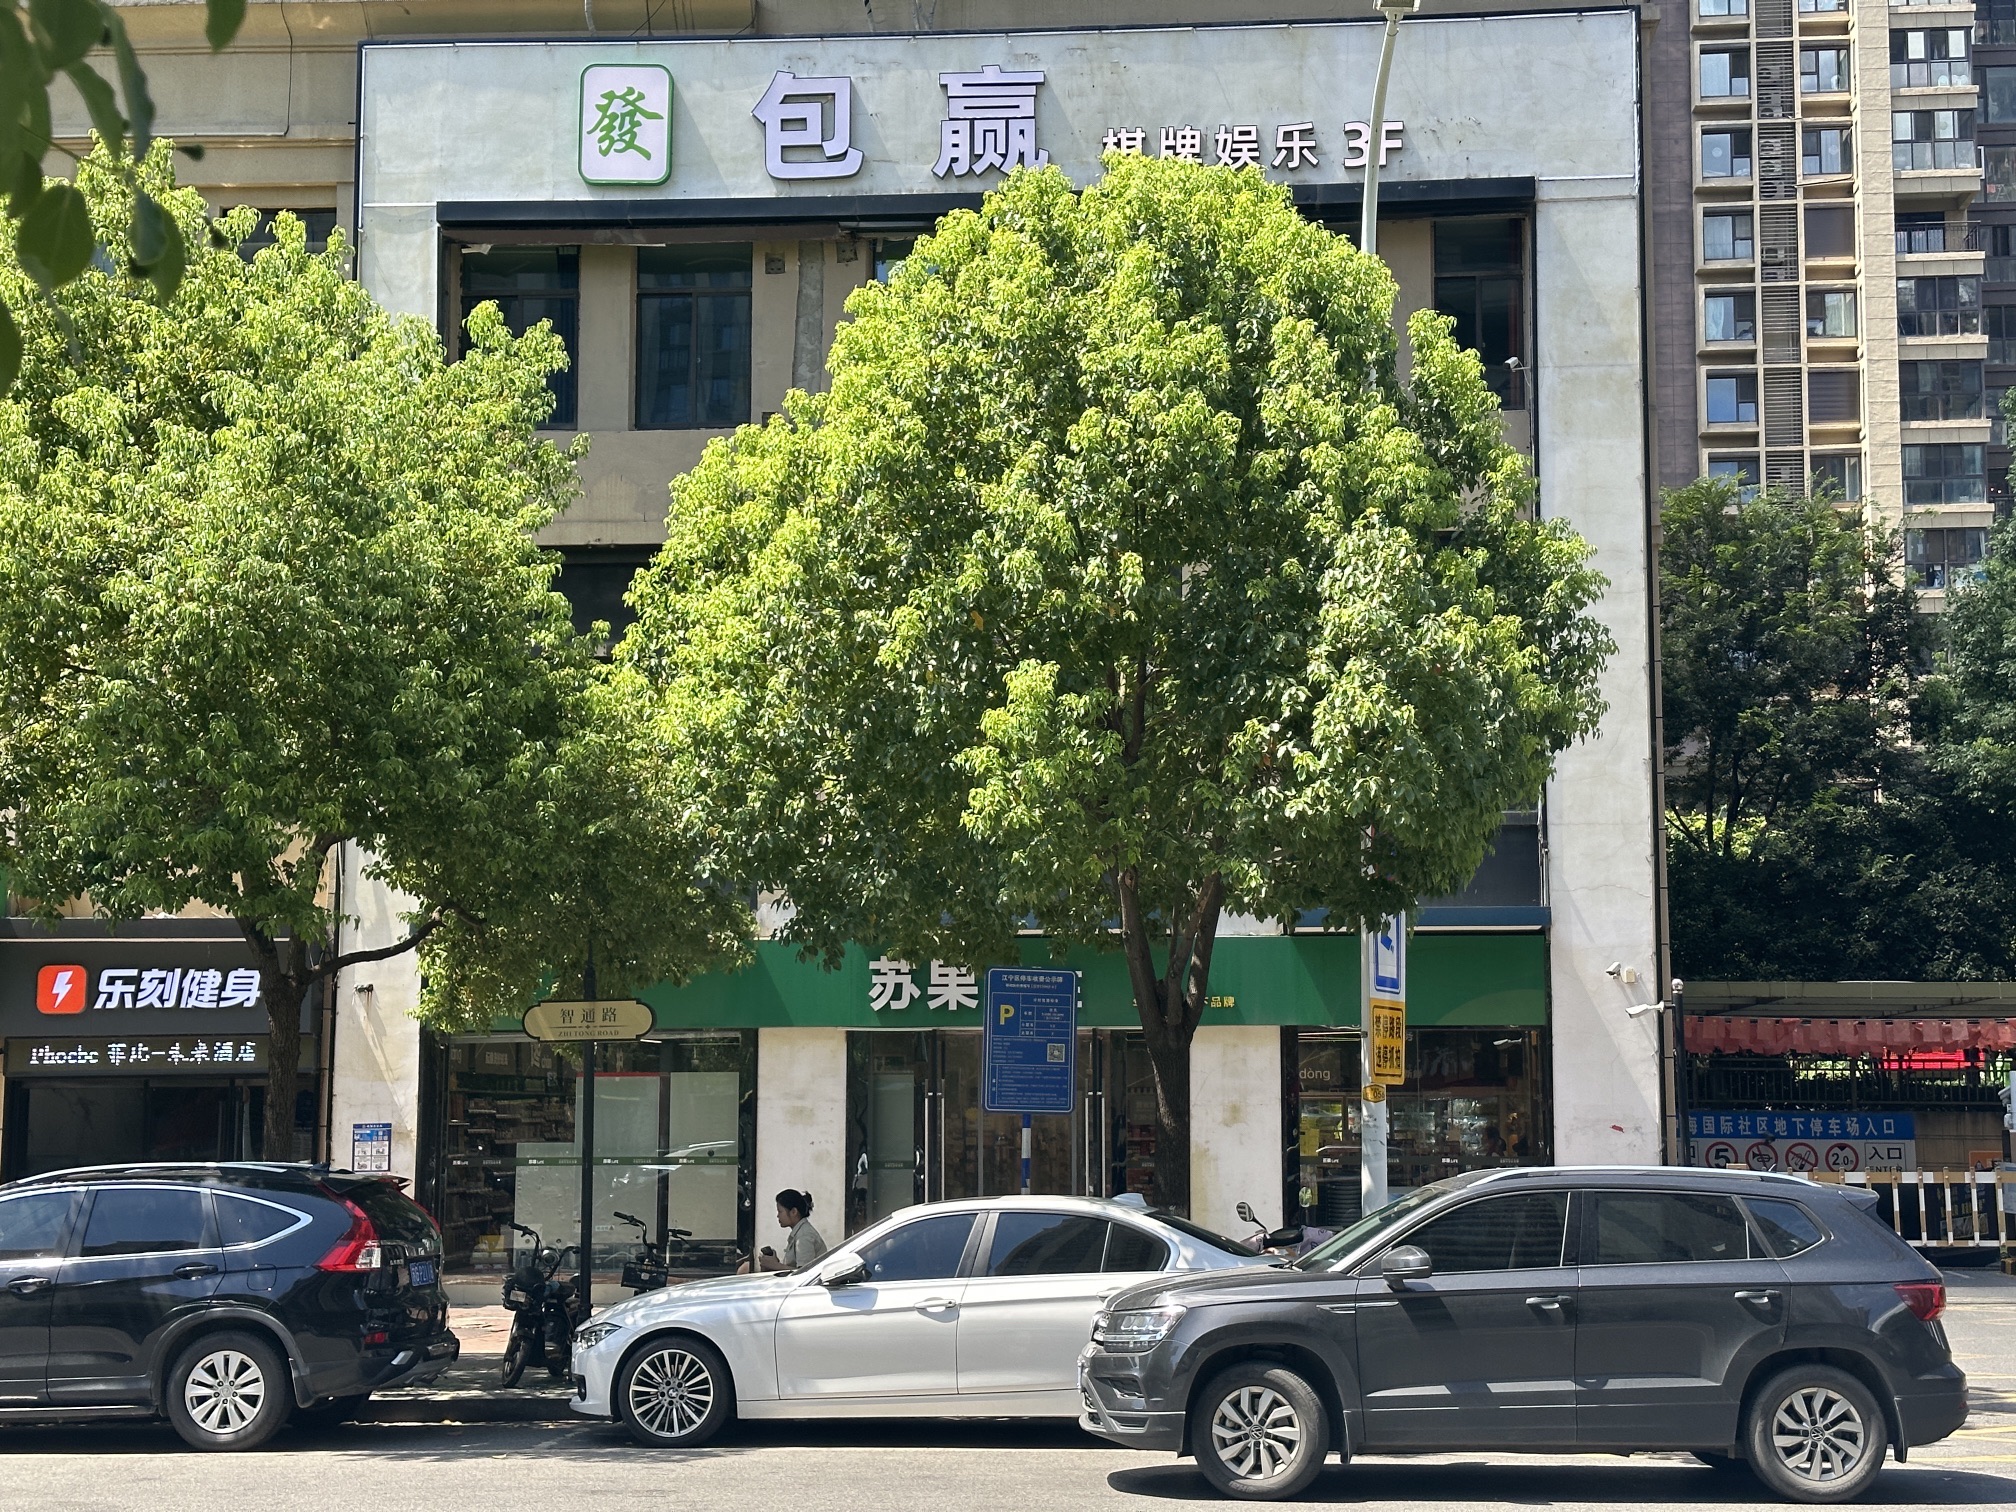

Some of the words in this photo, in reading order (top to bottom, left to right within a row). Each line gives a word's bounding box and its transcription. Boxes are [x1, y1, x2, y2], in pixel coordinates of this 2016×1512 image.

[585, 84, 665, 162] 發
[1342, 120, 1405, 169] 3F
[93, 966, 262, 1010] 乐刻健身
[560, 1006, 617, 1024] 智通路
[999, 1004, 1015, 1026] P
[1676, 1114, 1896, 1136] 海国际社区地下停车场入口
[1713, 1147, 1730, 1169] 5
[1868, 1146, 1902, 1161] 入口
